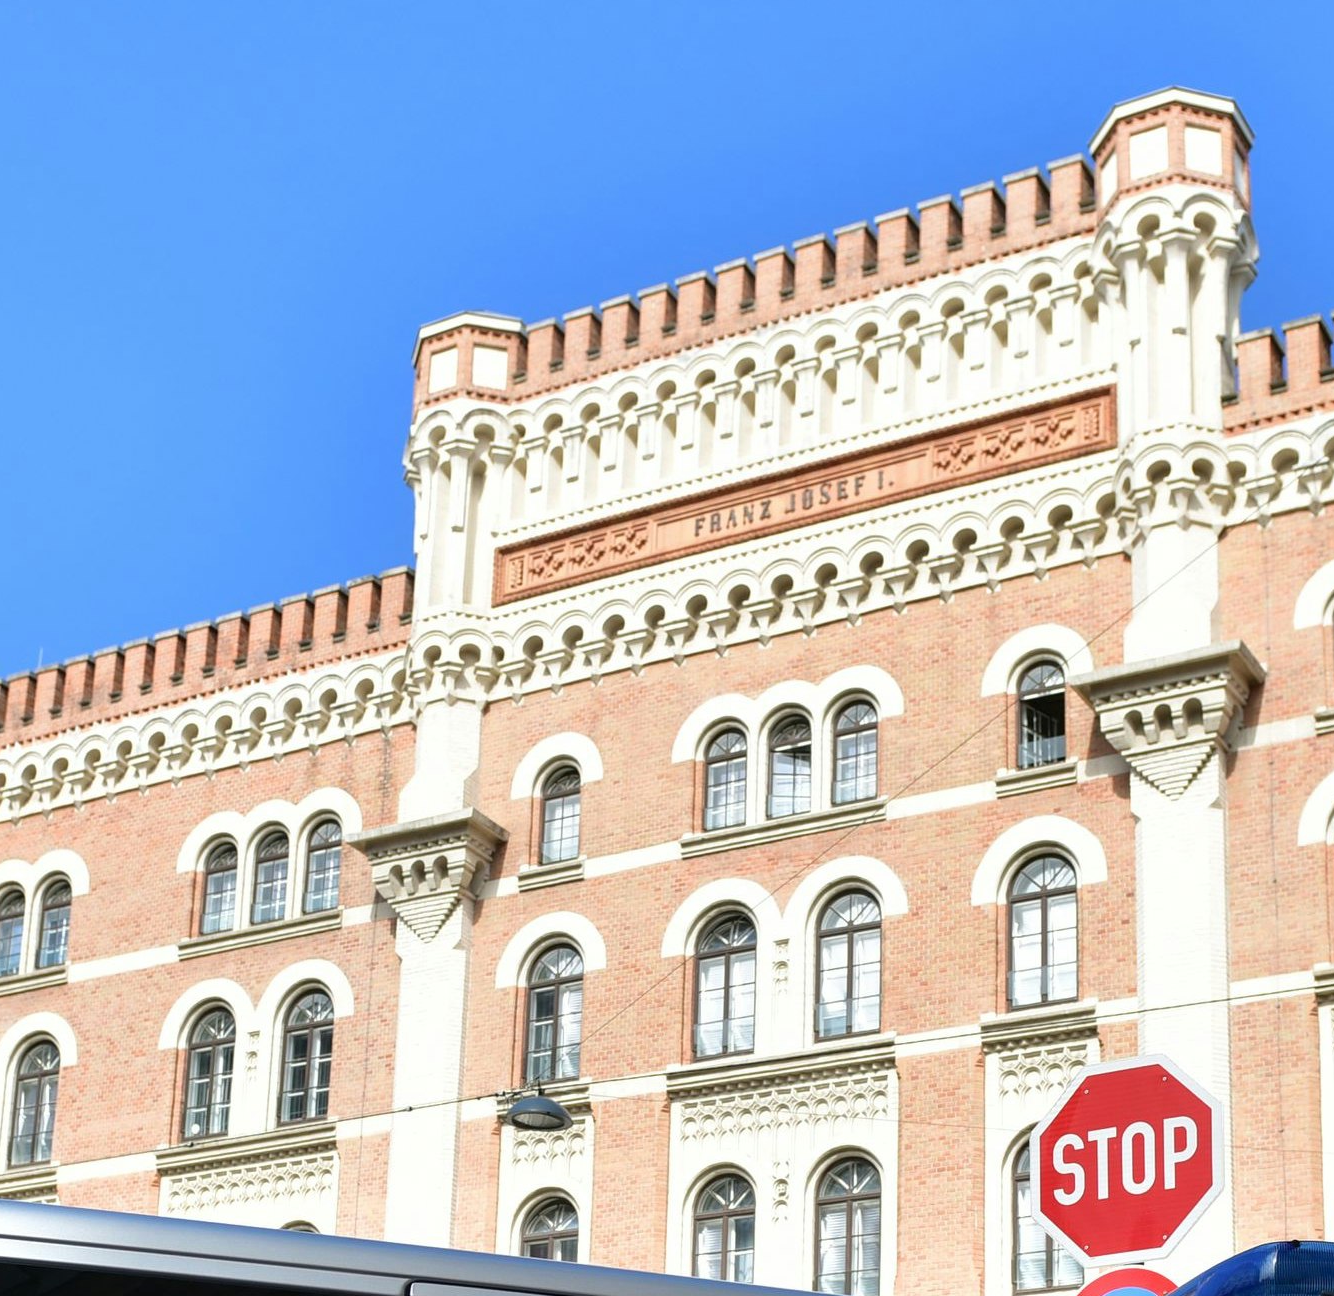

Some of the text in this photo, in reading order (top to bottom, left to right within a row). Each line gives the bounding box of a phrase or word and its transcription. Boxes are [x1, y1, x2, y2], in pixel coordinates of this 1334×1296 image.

[694, 500, 772, 537] FRANZ
[784, 475, 866, 514] JOSEF
[1052, 1115, 1198, 1206] STOP
